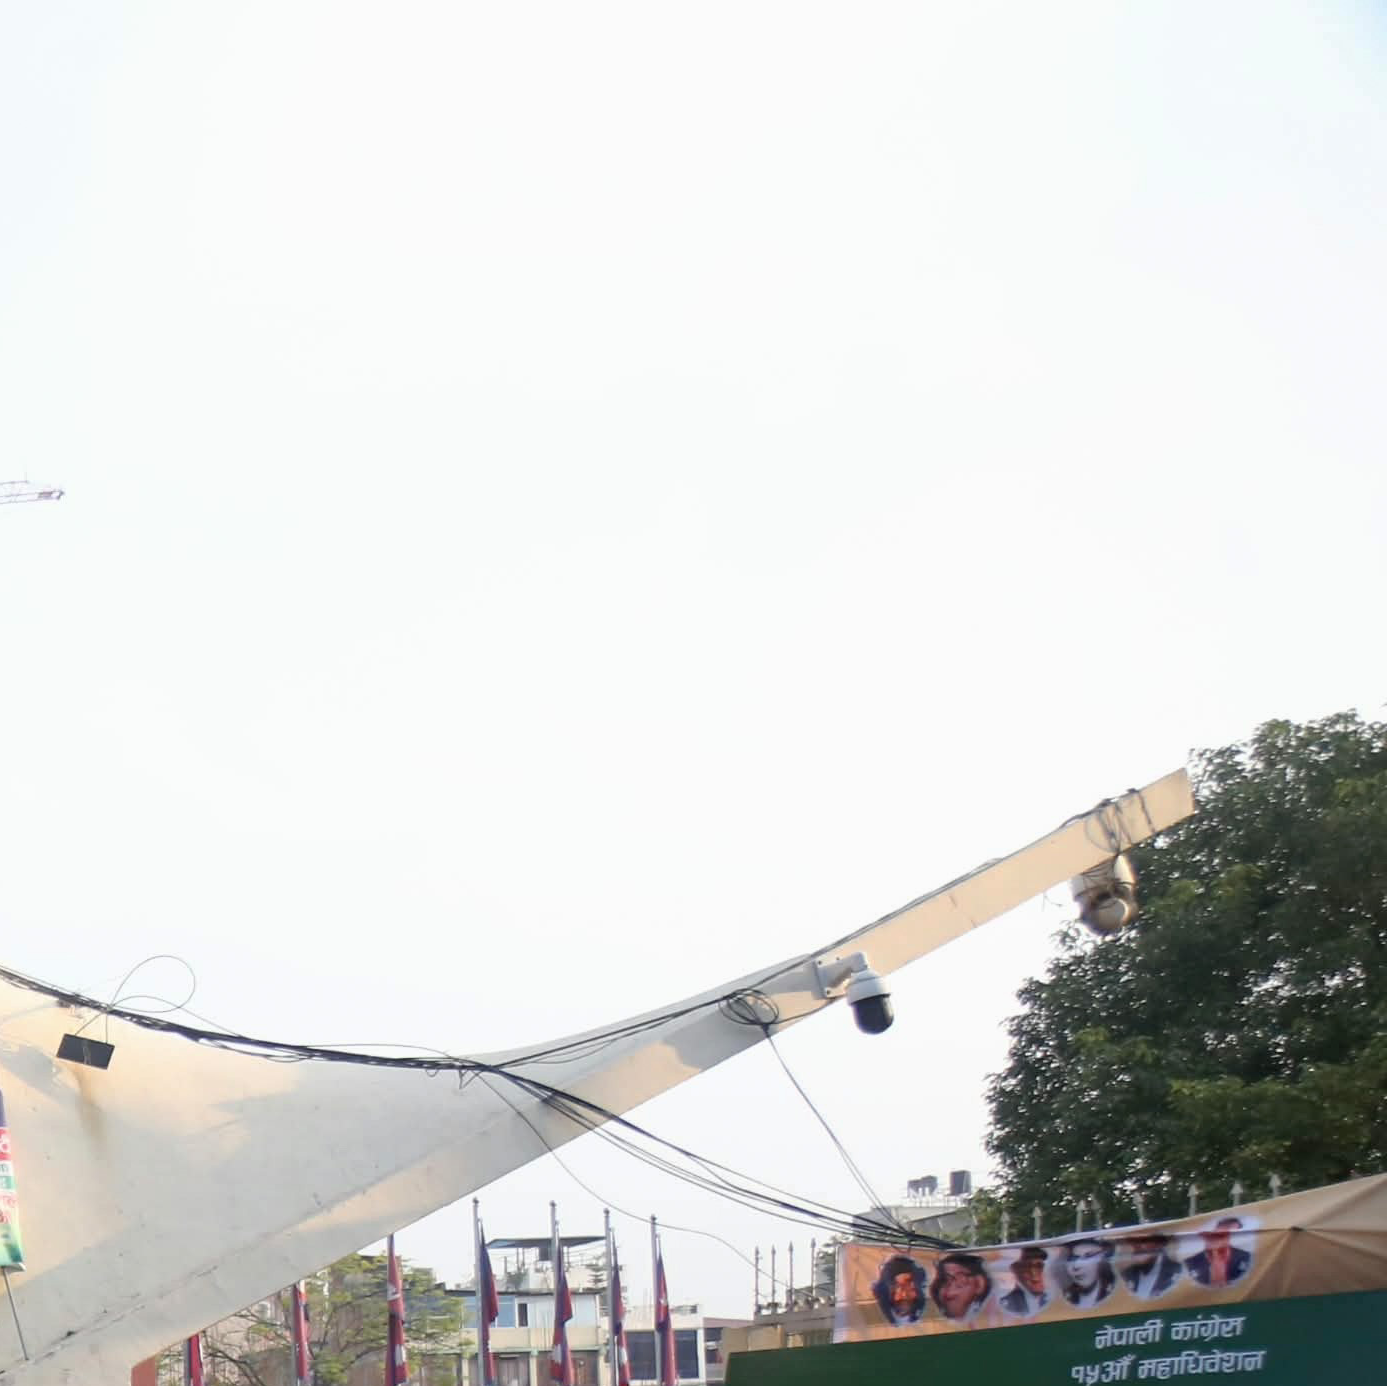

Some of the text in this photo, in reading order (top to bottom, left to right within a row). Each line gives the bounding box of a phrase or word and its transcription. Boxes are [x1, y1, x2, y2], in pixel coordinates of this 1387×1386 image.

[1094, 1314, 1247, 1349] नेपाली कांग्रेस
[1137, 1350, 1267, 1380] महाधिवेशन
